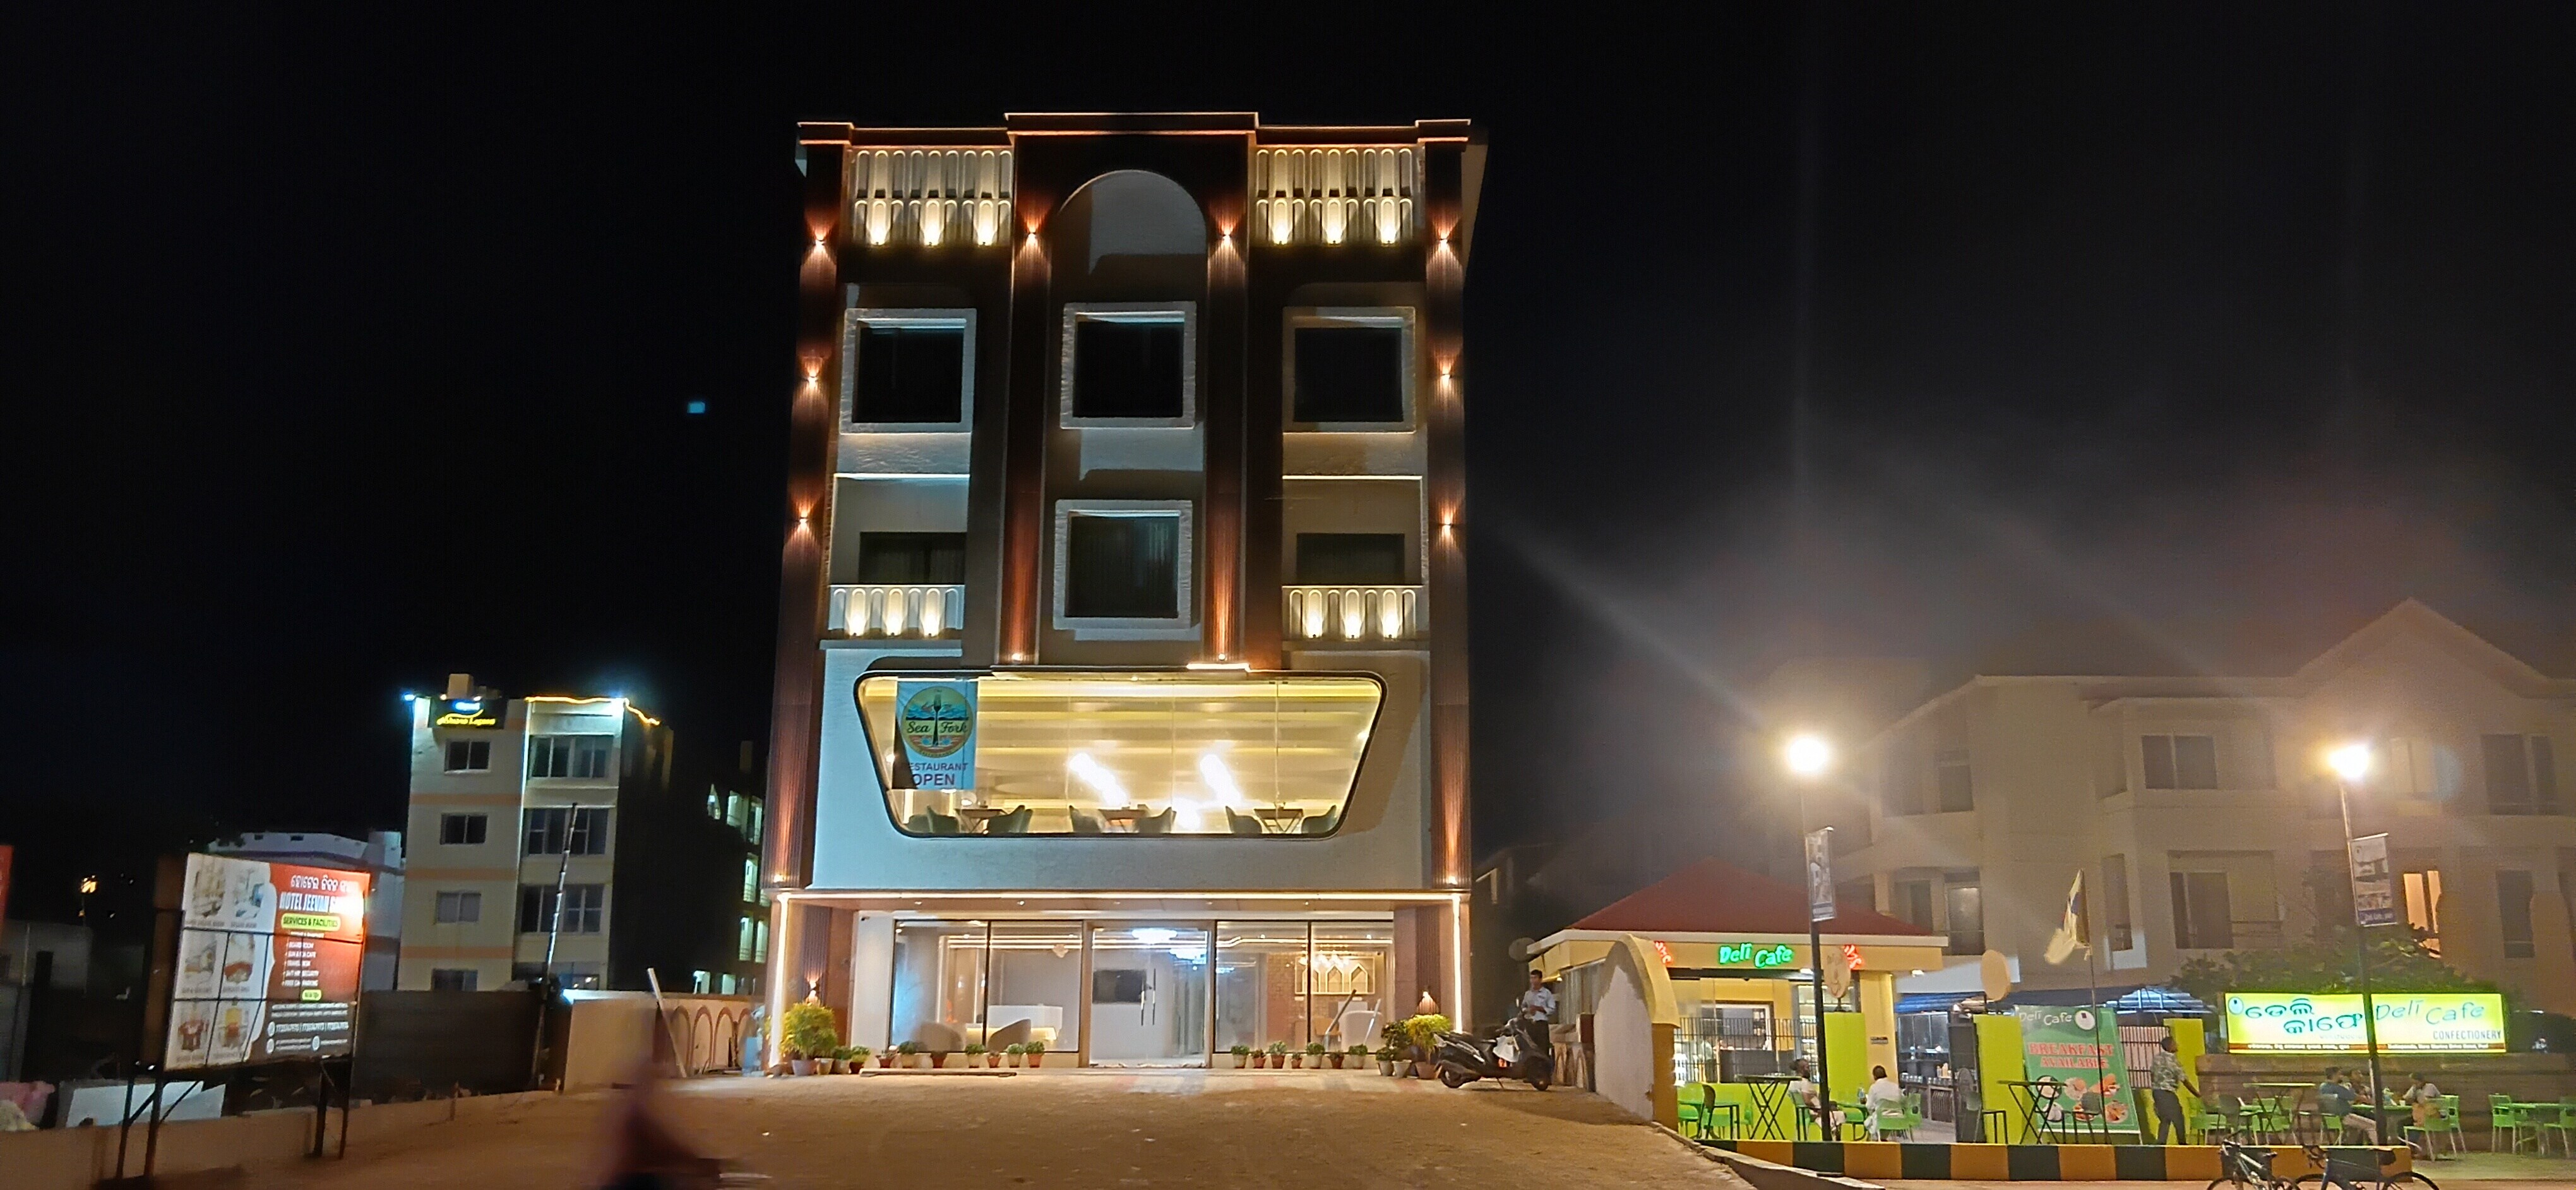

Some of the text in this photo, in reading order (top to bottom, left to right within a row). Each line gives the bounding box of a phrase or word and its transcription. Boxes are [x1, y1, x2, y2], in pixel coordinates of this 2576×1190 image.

[907, 721, 968, 733] Sea Fork
[909, 762, 968, 771] ESTAURANT
[912, 773, 955, 786] OPEN
[279, 891, 302, 910] HOTEL
[302, 893, 330, 913] JEEVAN
[283, 915, 307, 925] SERVICES
[313, 918, 338, 928] FACILITIES
[1719, 942, 1794, 968] Deli Cafe
[2019, 1011, 2073, 1026] Deli Cafe
[2376, 1000, 2484, 1025] Deli Cafe
[2433, 1030, 2501, 1040] CONFECTIONERY
[2029, 1042, 2114, 1056] BREAKFAST
[2040, 1056, 2109, 1069] AVAILABLE
